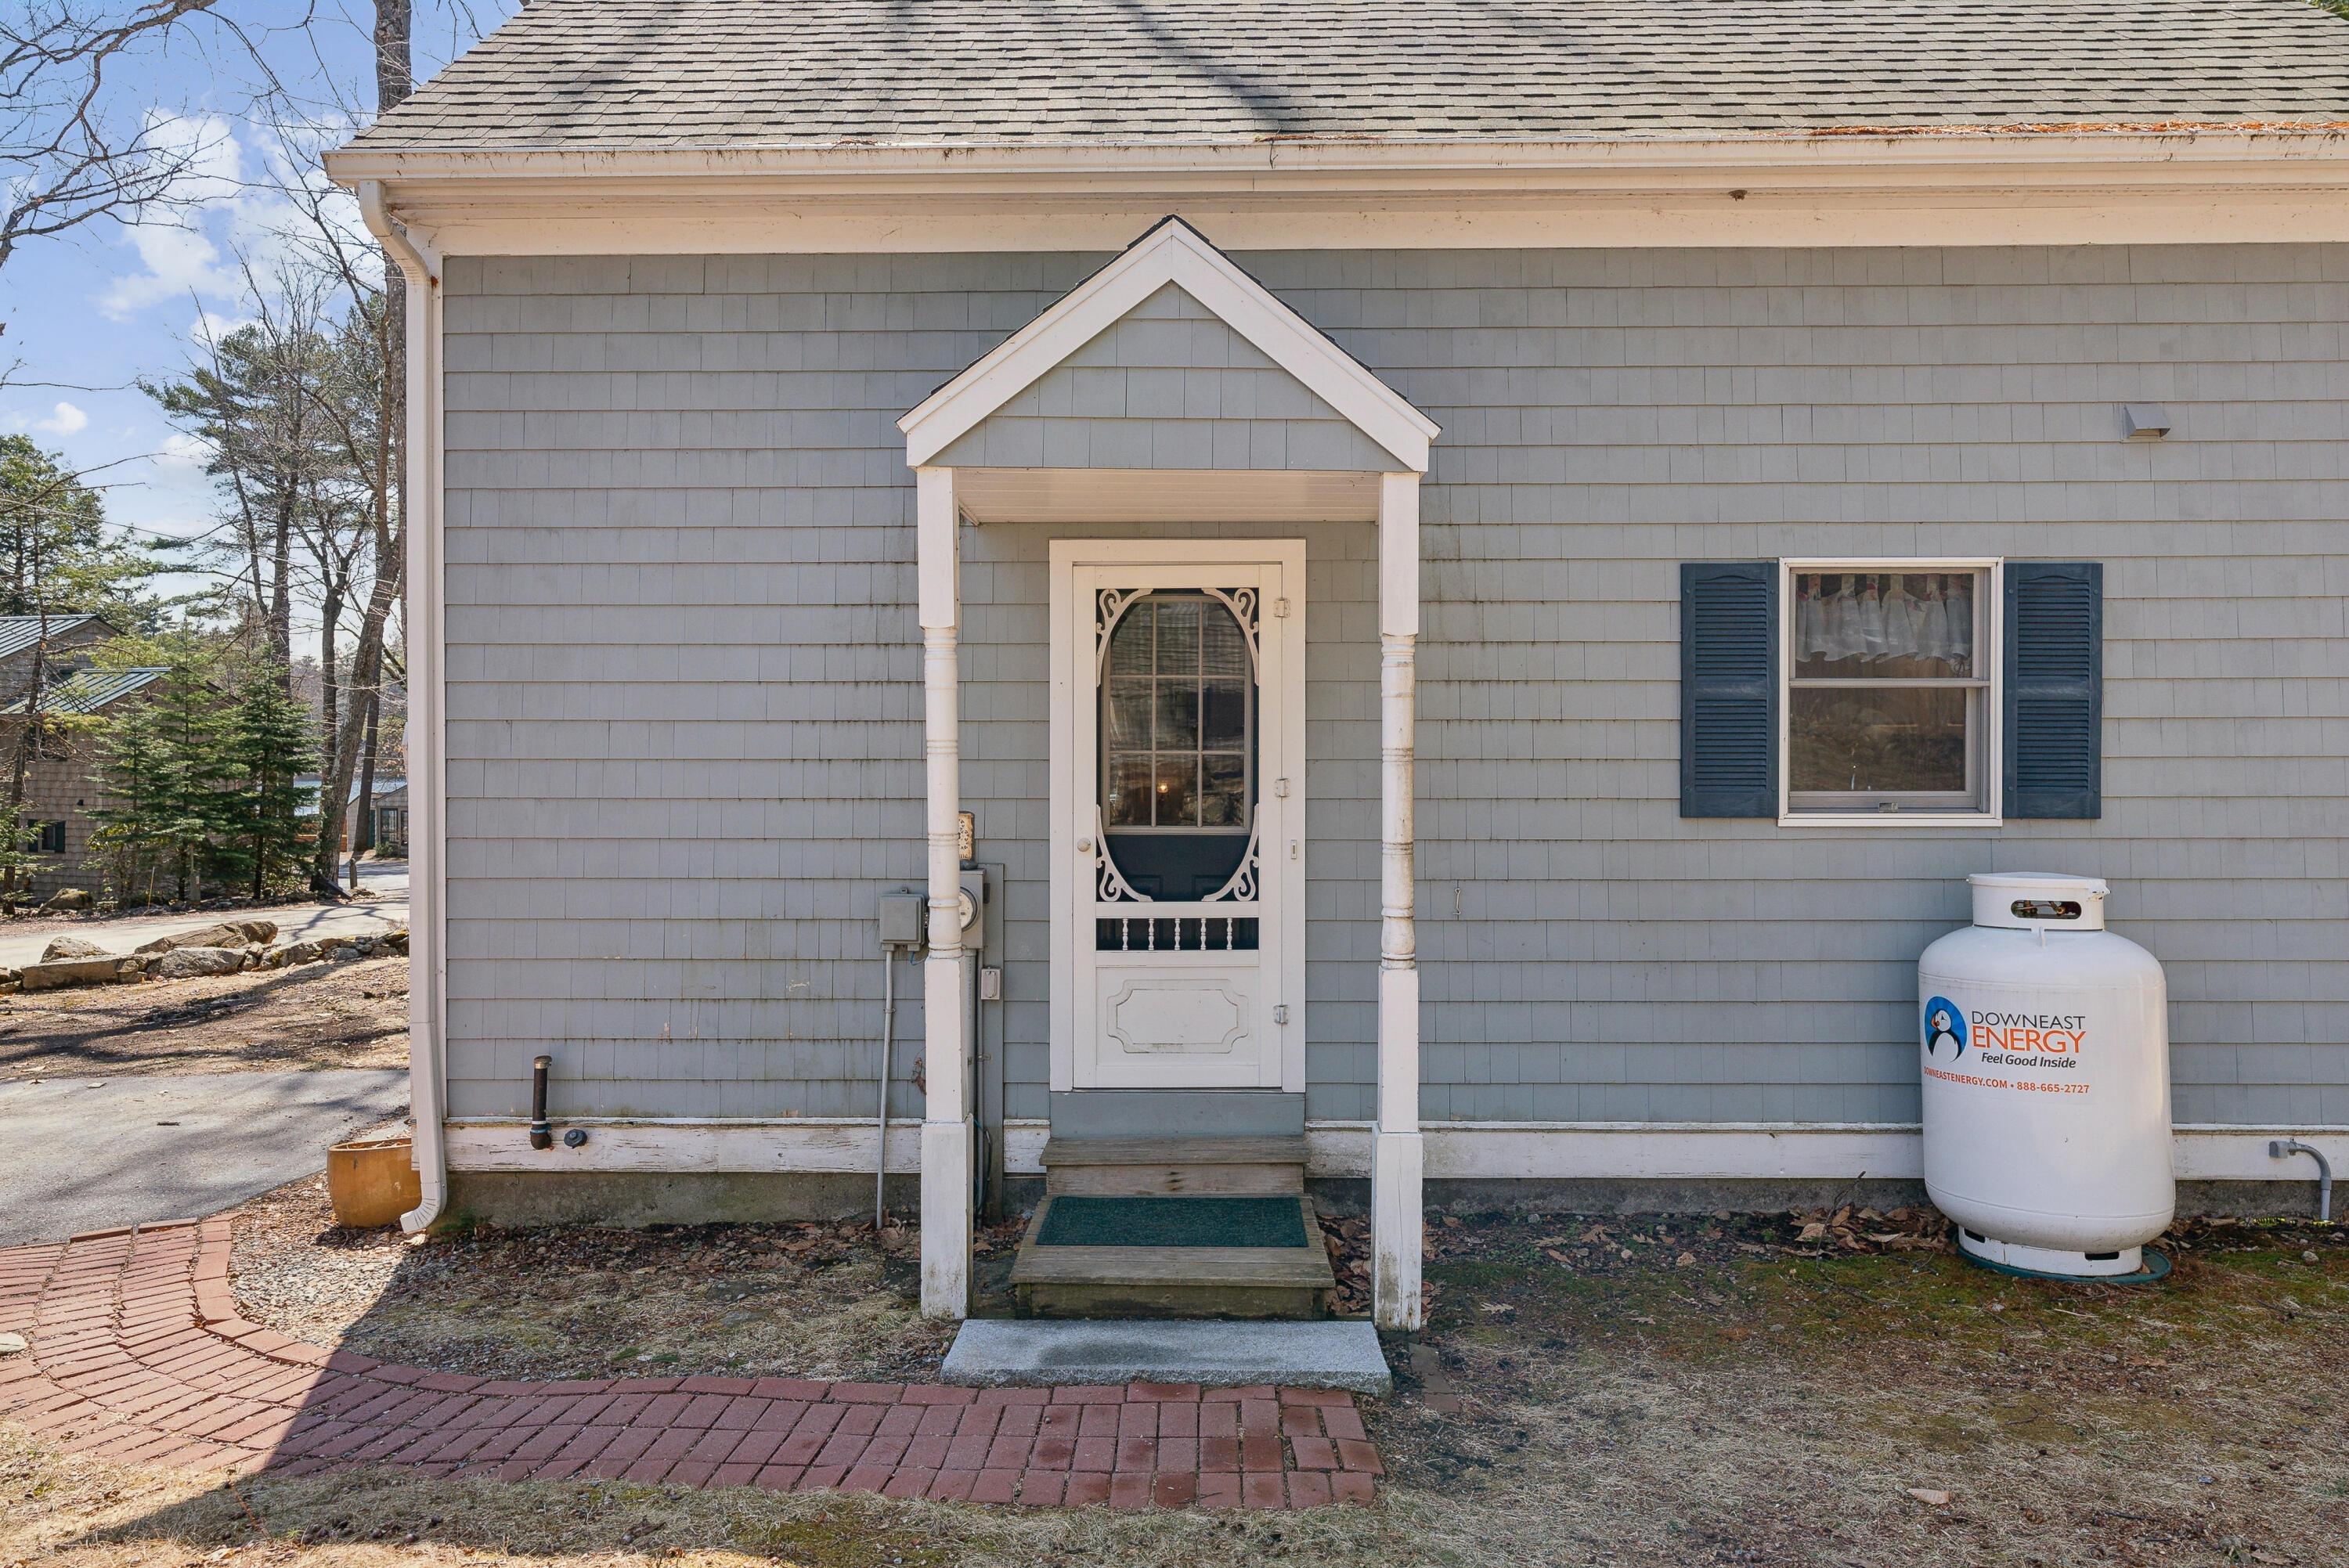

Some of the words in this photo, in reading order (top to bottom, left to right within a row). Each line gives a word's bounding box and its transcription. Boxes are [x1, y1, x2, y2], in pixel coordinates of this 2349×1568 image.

[1972, 1011, 2086, 1029] DOWNEAST
[1972, 1026, 2087, 1053] ENERGY
[1981, 1052, 2003, 1064] Feel
[2005, 1054, 2037, 1067] Good
[2040, 1056, 2077, 1069] Inside
[1924, 1065, 2008, 1089] DOWNEASTENERGY.COM
[2017, 1082, 2089, 1094] 888-665-2727
